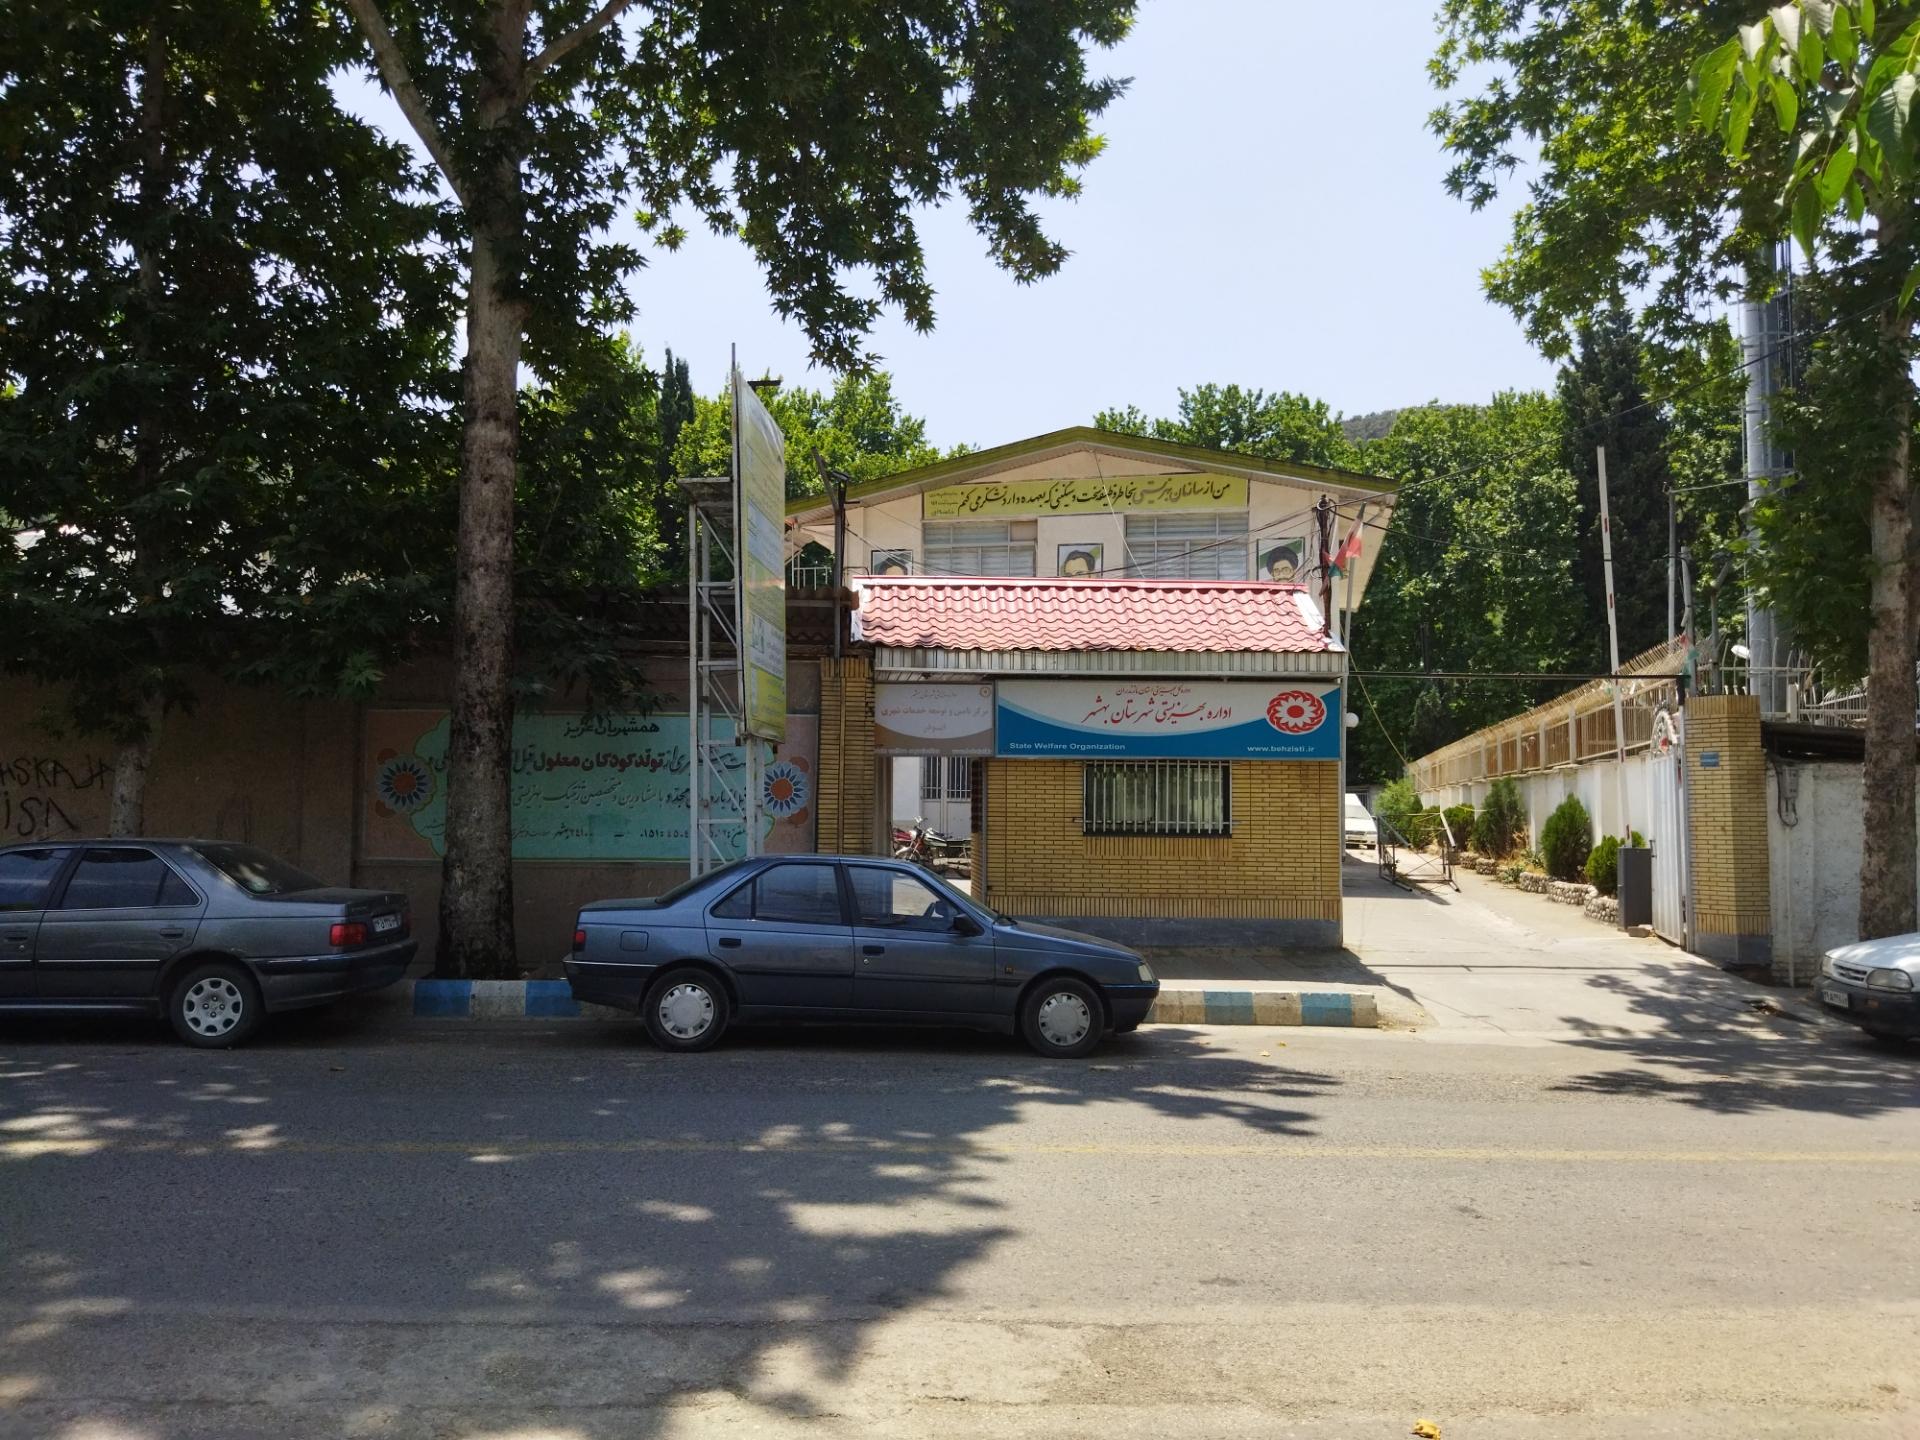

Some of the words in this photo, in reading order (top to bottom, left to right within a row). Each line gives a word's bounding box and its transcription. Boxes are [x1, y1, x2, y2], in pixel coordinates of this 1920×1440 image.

[1134, 478, 1172, 504] بهزیستی
[1170, 482, 1203, 502] سازمان
[1203, 481, 1214, 495] از
[1213, 483, 1231, 499] من
[1081, 695, 1110, 724] بهشهر
[1111, 697, 1154, 724] شهرستان
[1155, 702, 1207, 724] بهزیستی
[1207, 706, 1232, 720] اداره
[1009, 742, 1033, 750] State
[1034, 742, 1068, 750] Welfare
[1069, 743, 1126, 752] Organization
[1247, 745, 1316, 753] www.behzisti.ir
